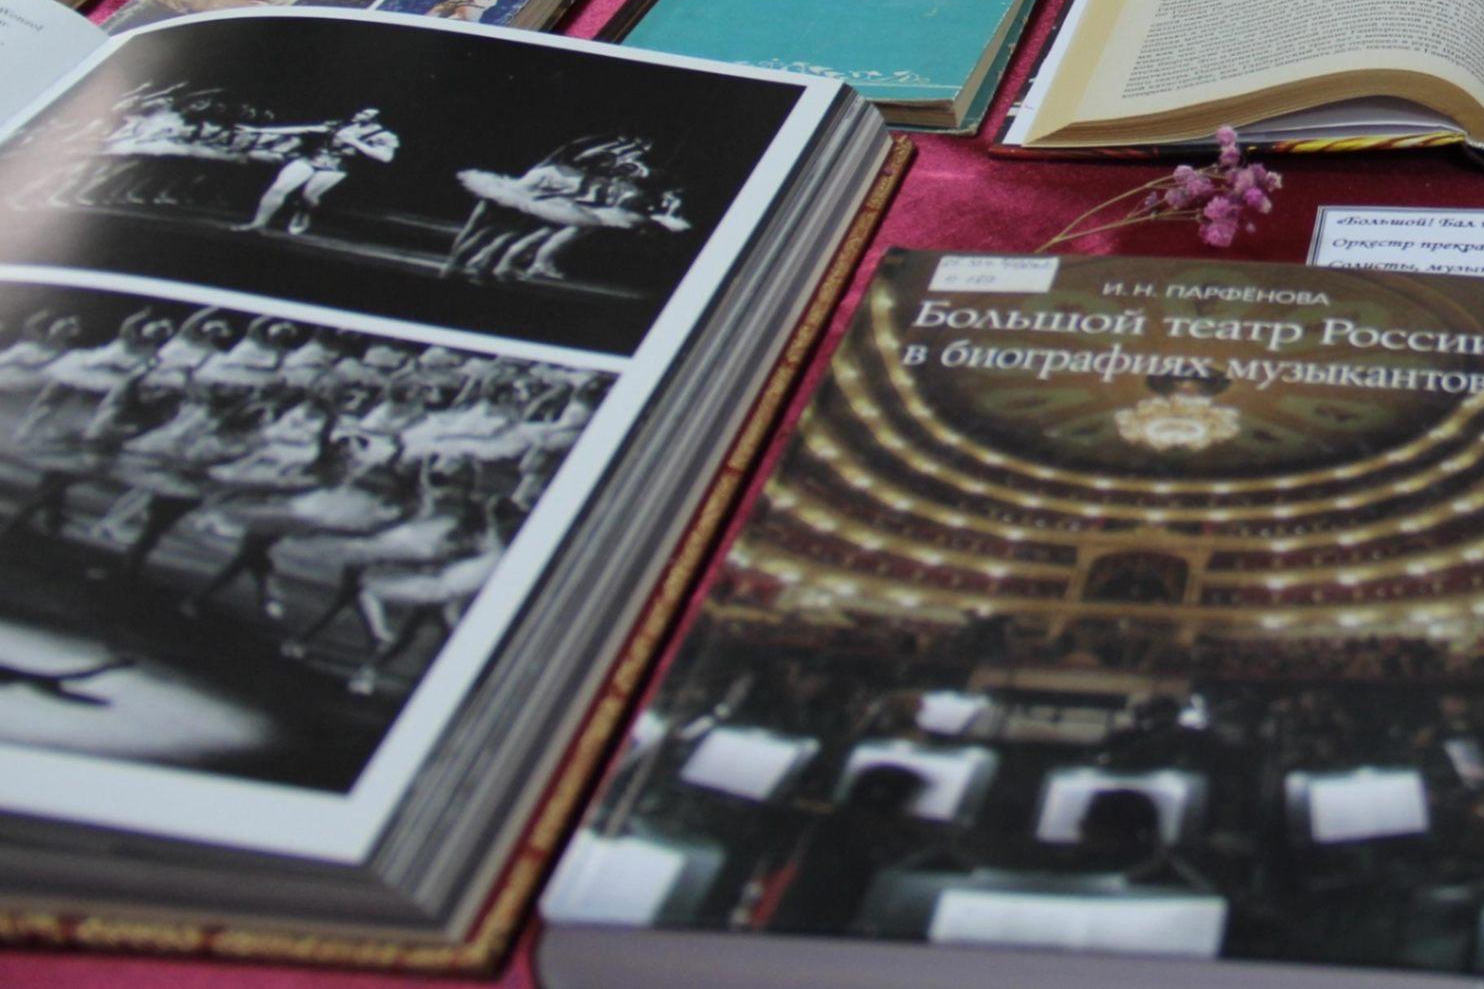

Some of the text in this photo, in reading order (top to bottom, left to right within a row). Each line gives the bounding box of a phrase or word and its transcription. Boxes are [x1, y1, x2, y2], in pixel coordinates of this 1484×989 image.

[1438, 218, 1475, 228] Бал
[1333, 238, 1414, 250] Оркестр
[1102, 281, 1331, 308] И. Н. ПАРФЁНОВА
[913, 300, 1146, 337] Большой
[1162, 315, 1303, 347] театр
[902, 343, 925, 367] в
[941, 340, 1212, 383] биографиях
